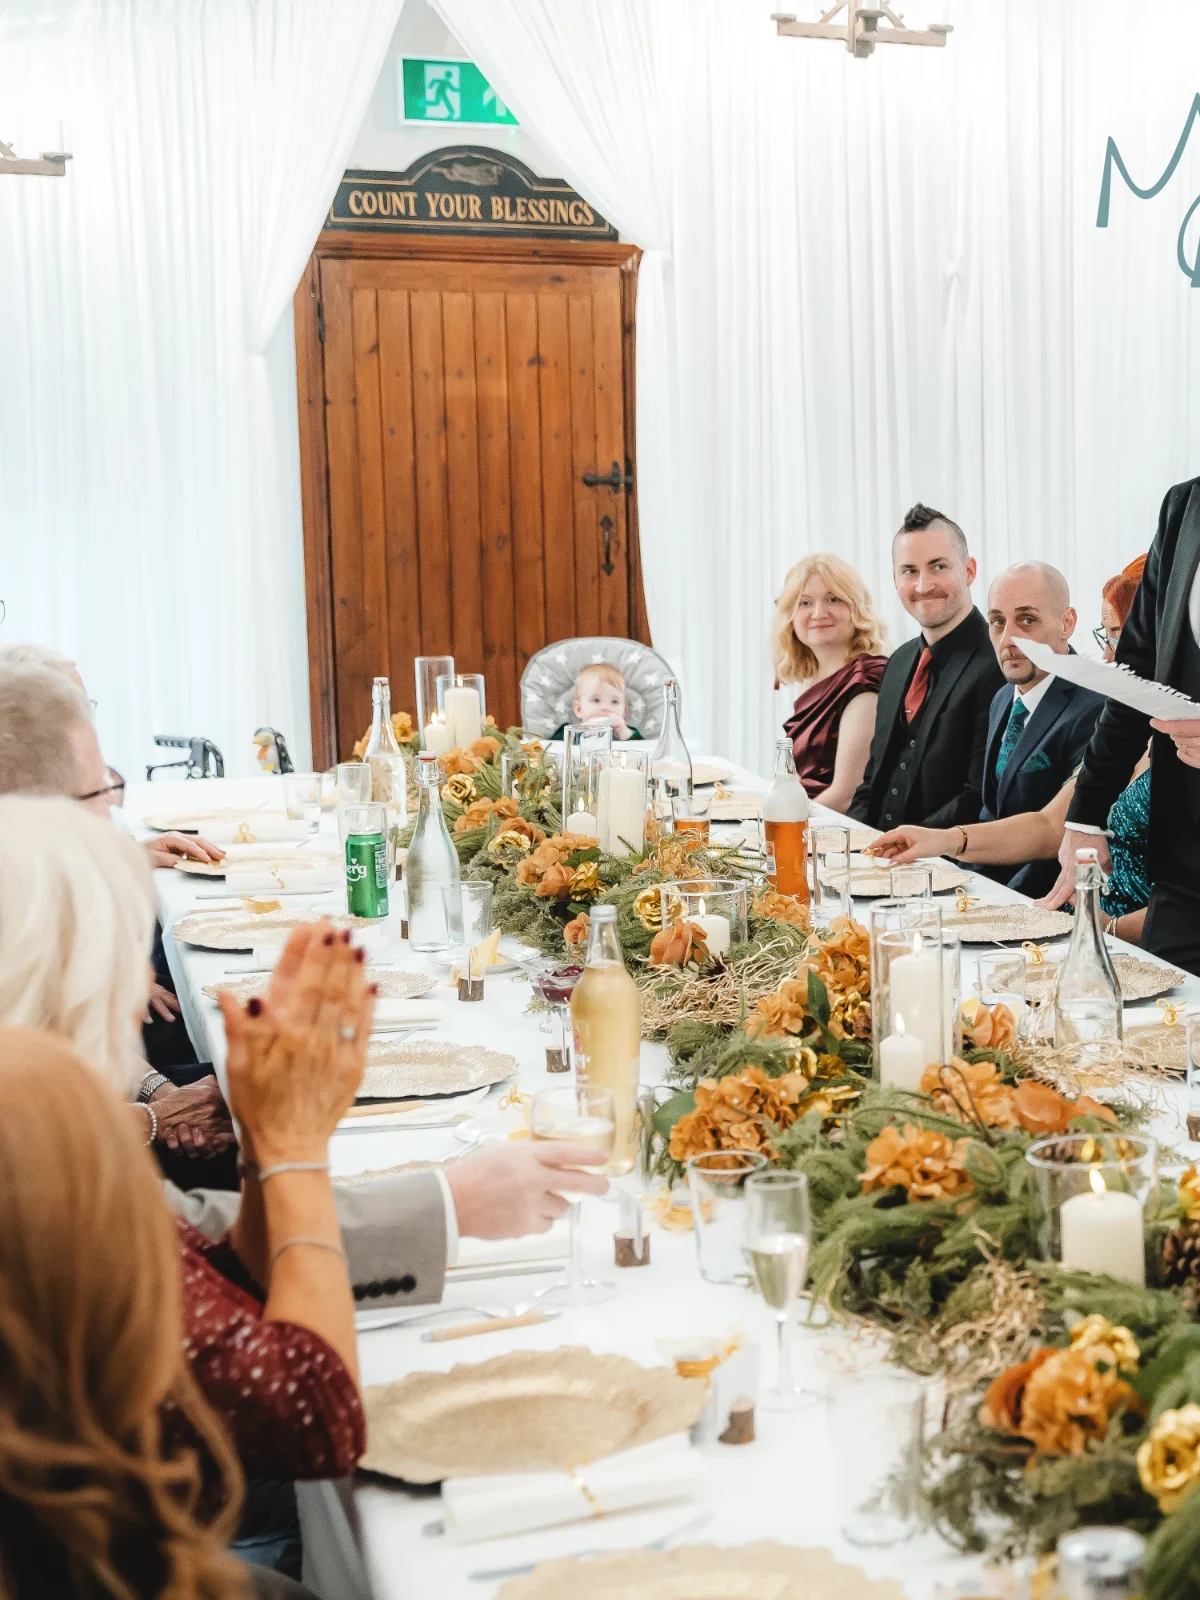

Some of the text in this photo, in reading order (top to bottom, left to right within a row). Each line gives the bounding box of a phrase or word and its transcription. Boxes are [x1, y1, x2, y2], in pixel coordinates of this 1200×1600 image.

[348, 190, 595, 225] COUNT YOUR BLESSINGS
